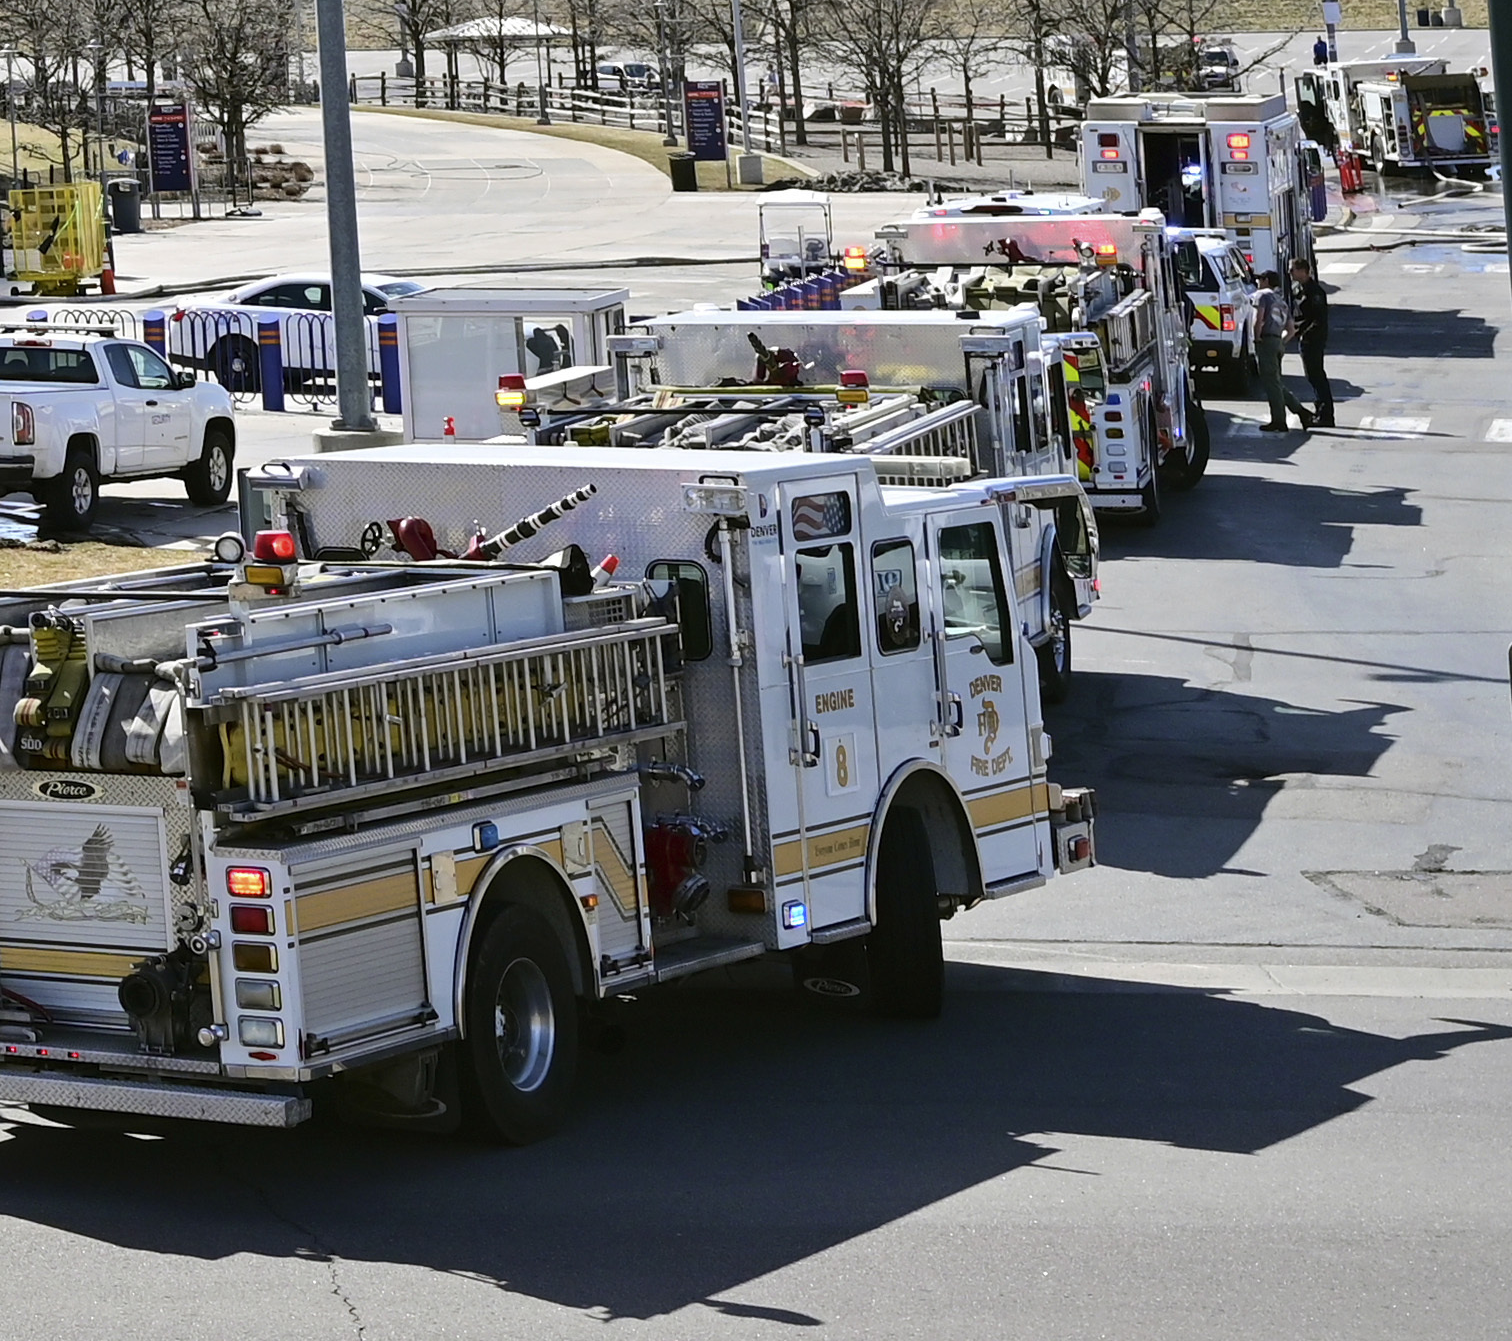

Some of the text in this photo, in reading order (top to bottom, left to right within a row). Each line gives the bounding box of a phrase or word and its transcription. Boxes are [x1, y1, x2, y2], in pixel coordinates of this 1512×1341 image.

[751, 525, 777, 538] DENVER
[969, 675, 1002, 699] DENVER
[816, 688, 854, 714] ENGINE
[835, 744, 849, 787] 8
[971, 746, 1013, 777] FIRE DEPT.
[47, 781, 88, 796] Pierce
